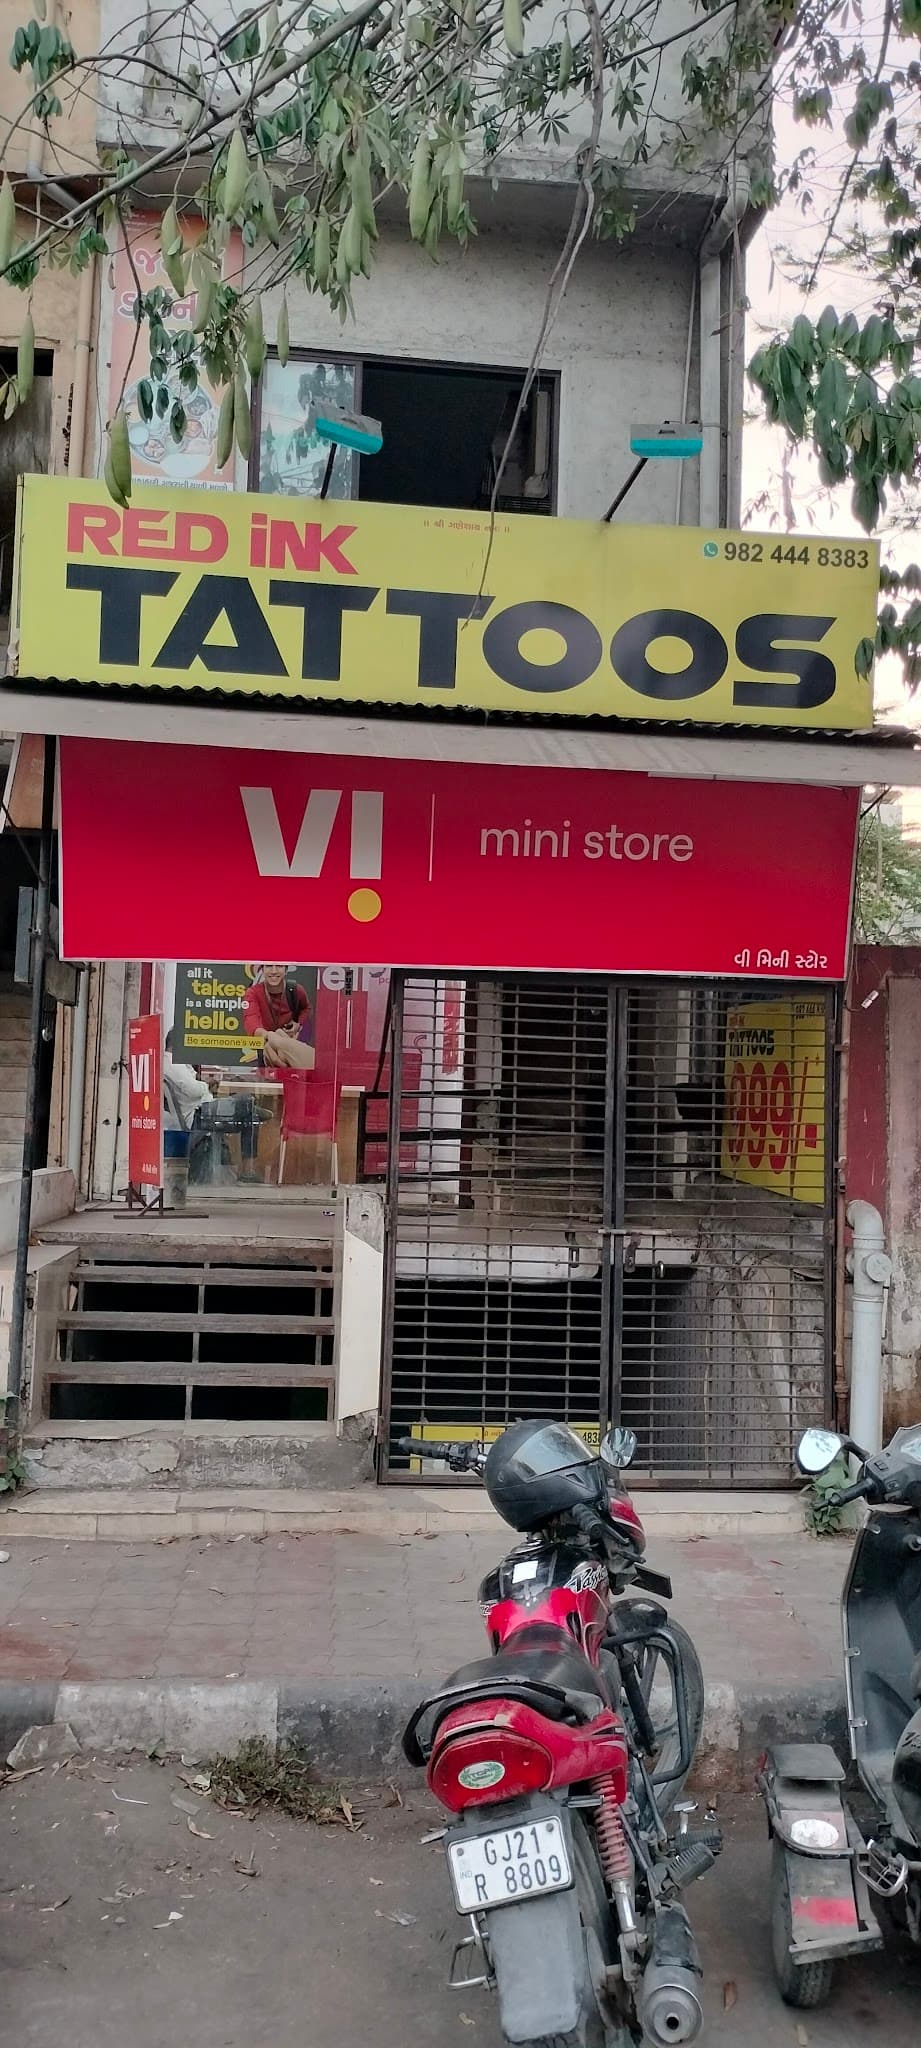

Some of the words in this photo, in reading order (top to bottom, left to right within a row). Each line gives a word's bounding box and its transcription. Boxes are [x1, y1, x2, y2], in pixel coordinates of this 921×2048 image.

[67, 502, 229, 563] RED
[724, 542, 763, 562] 982
[770, 545, 809, 565] 444
[817, 547, 869, 568] 8383
[66, 563, 838, 710] TATTOOS
[480, 819, 571, 858] mini
[583, 825, 693, 862] store
[734, 949, 750, 967] વી
[757, 949, 789, 968] મિની
[795, 950, 827, 968] સ્ટોર
[187, 967, 201, 978] all
[204, 967, 213, 978] it
[192, 978, 246, 997] takes
[186, 998, 194, 1007] is
[205, 996, 250, 1011] simple
[185, 1010, 239, 1030] hello
[187, 1036, 198, 1044] Be
[200, 1037, 247, 1047] someone's
[729, 1030, 775, 1056] TATTOOS
[131, 1116, 142, 1128] mini
[143, 1117, 156, 1130] store
[484, 1826, 540, 1865] GJ21
[475, 1873, 488, 1901] R
[504, 1855, 562, 1893] 8809
